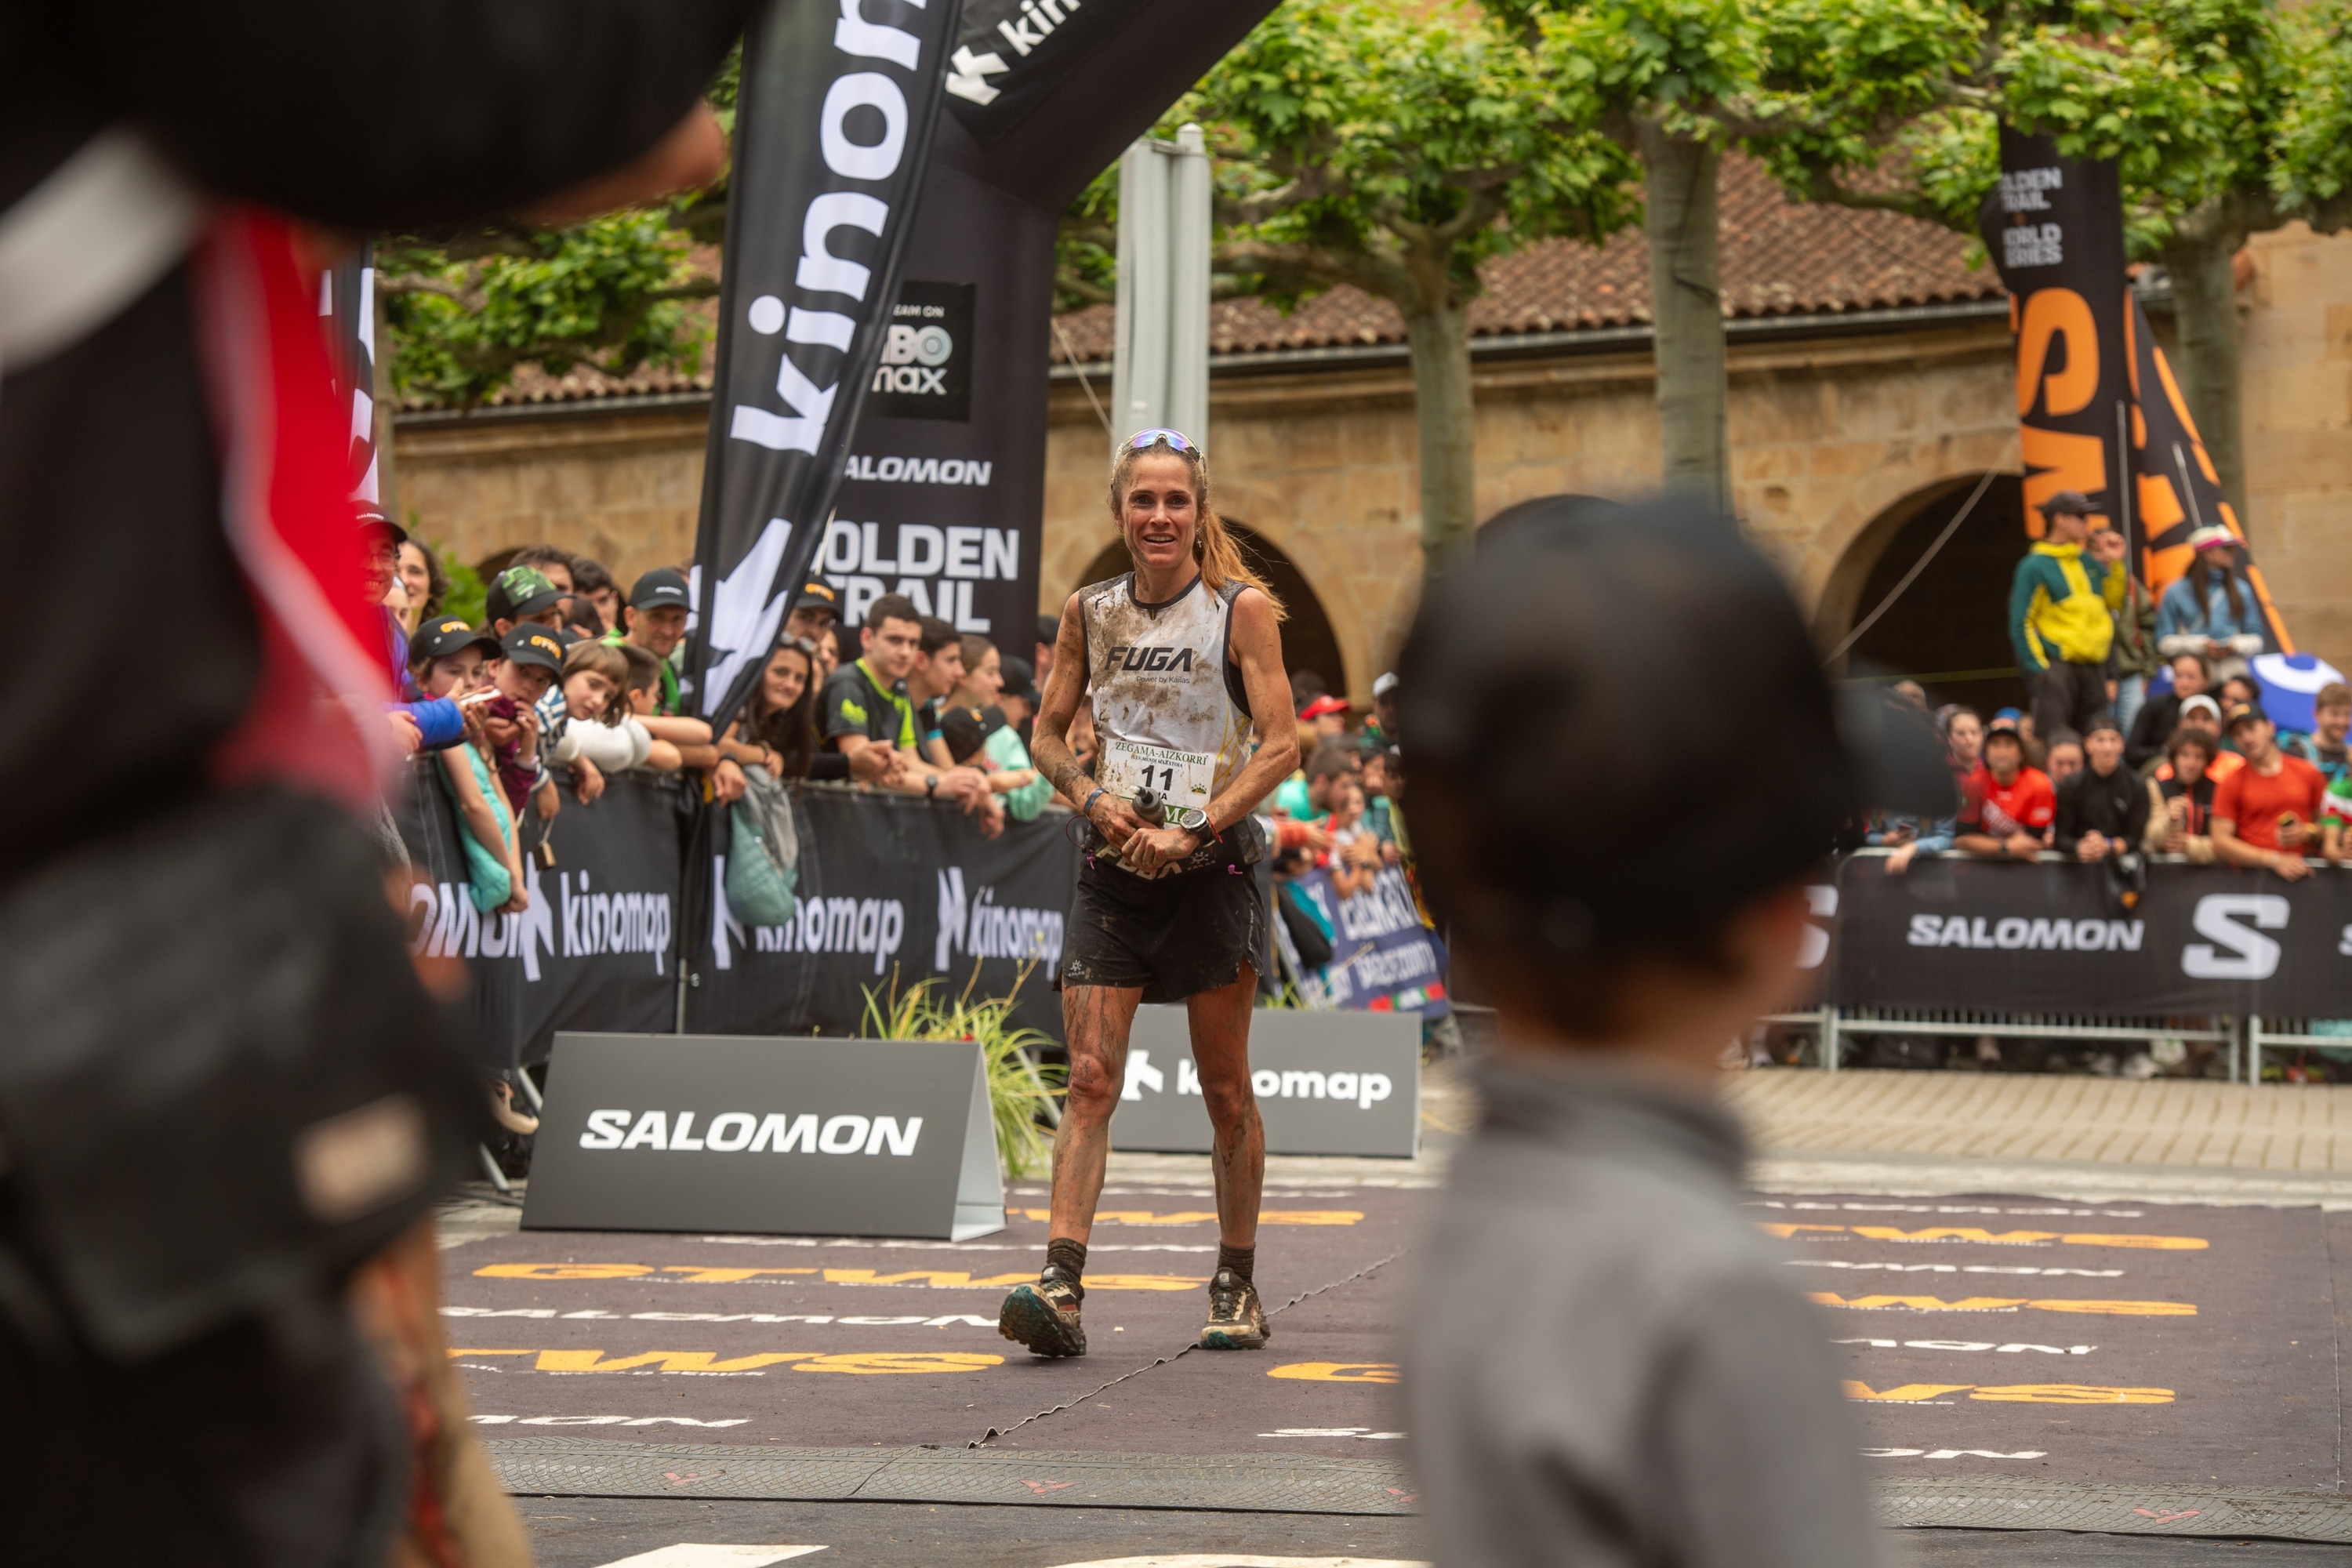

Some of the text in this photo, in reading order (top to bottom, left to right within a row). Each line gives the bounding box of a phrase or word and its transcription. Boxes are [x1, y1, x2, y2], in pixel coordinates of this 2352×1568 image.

[844, 456, 992, 485] ALOMON
[1104, 646, 1192, 672] FUGA
[1159, 676, 1167, 684] by
[1116, 742, 1207, 765] ZEGAMA-AIZKORRI
[1142, 764, 1174, 791] 11
[561, 869, 670, 975] kinomap
[967, 886, 1065, 981] kinomap
[1907, 914, 2145, 951] SALOMON
[2180, 892, 2291, 980] S
[1178, 1058, 1392, 1110] komap
[579, 1109, 924, 1156] SALOMON
[473, 1263, 1212, 1290] GTWS
[437, 1306, 1000, 1327] SALOMON
[447, 1347, 1006, 1375] TWS
